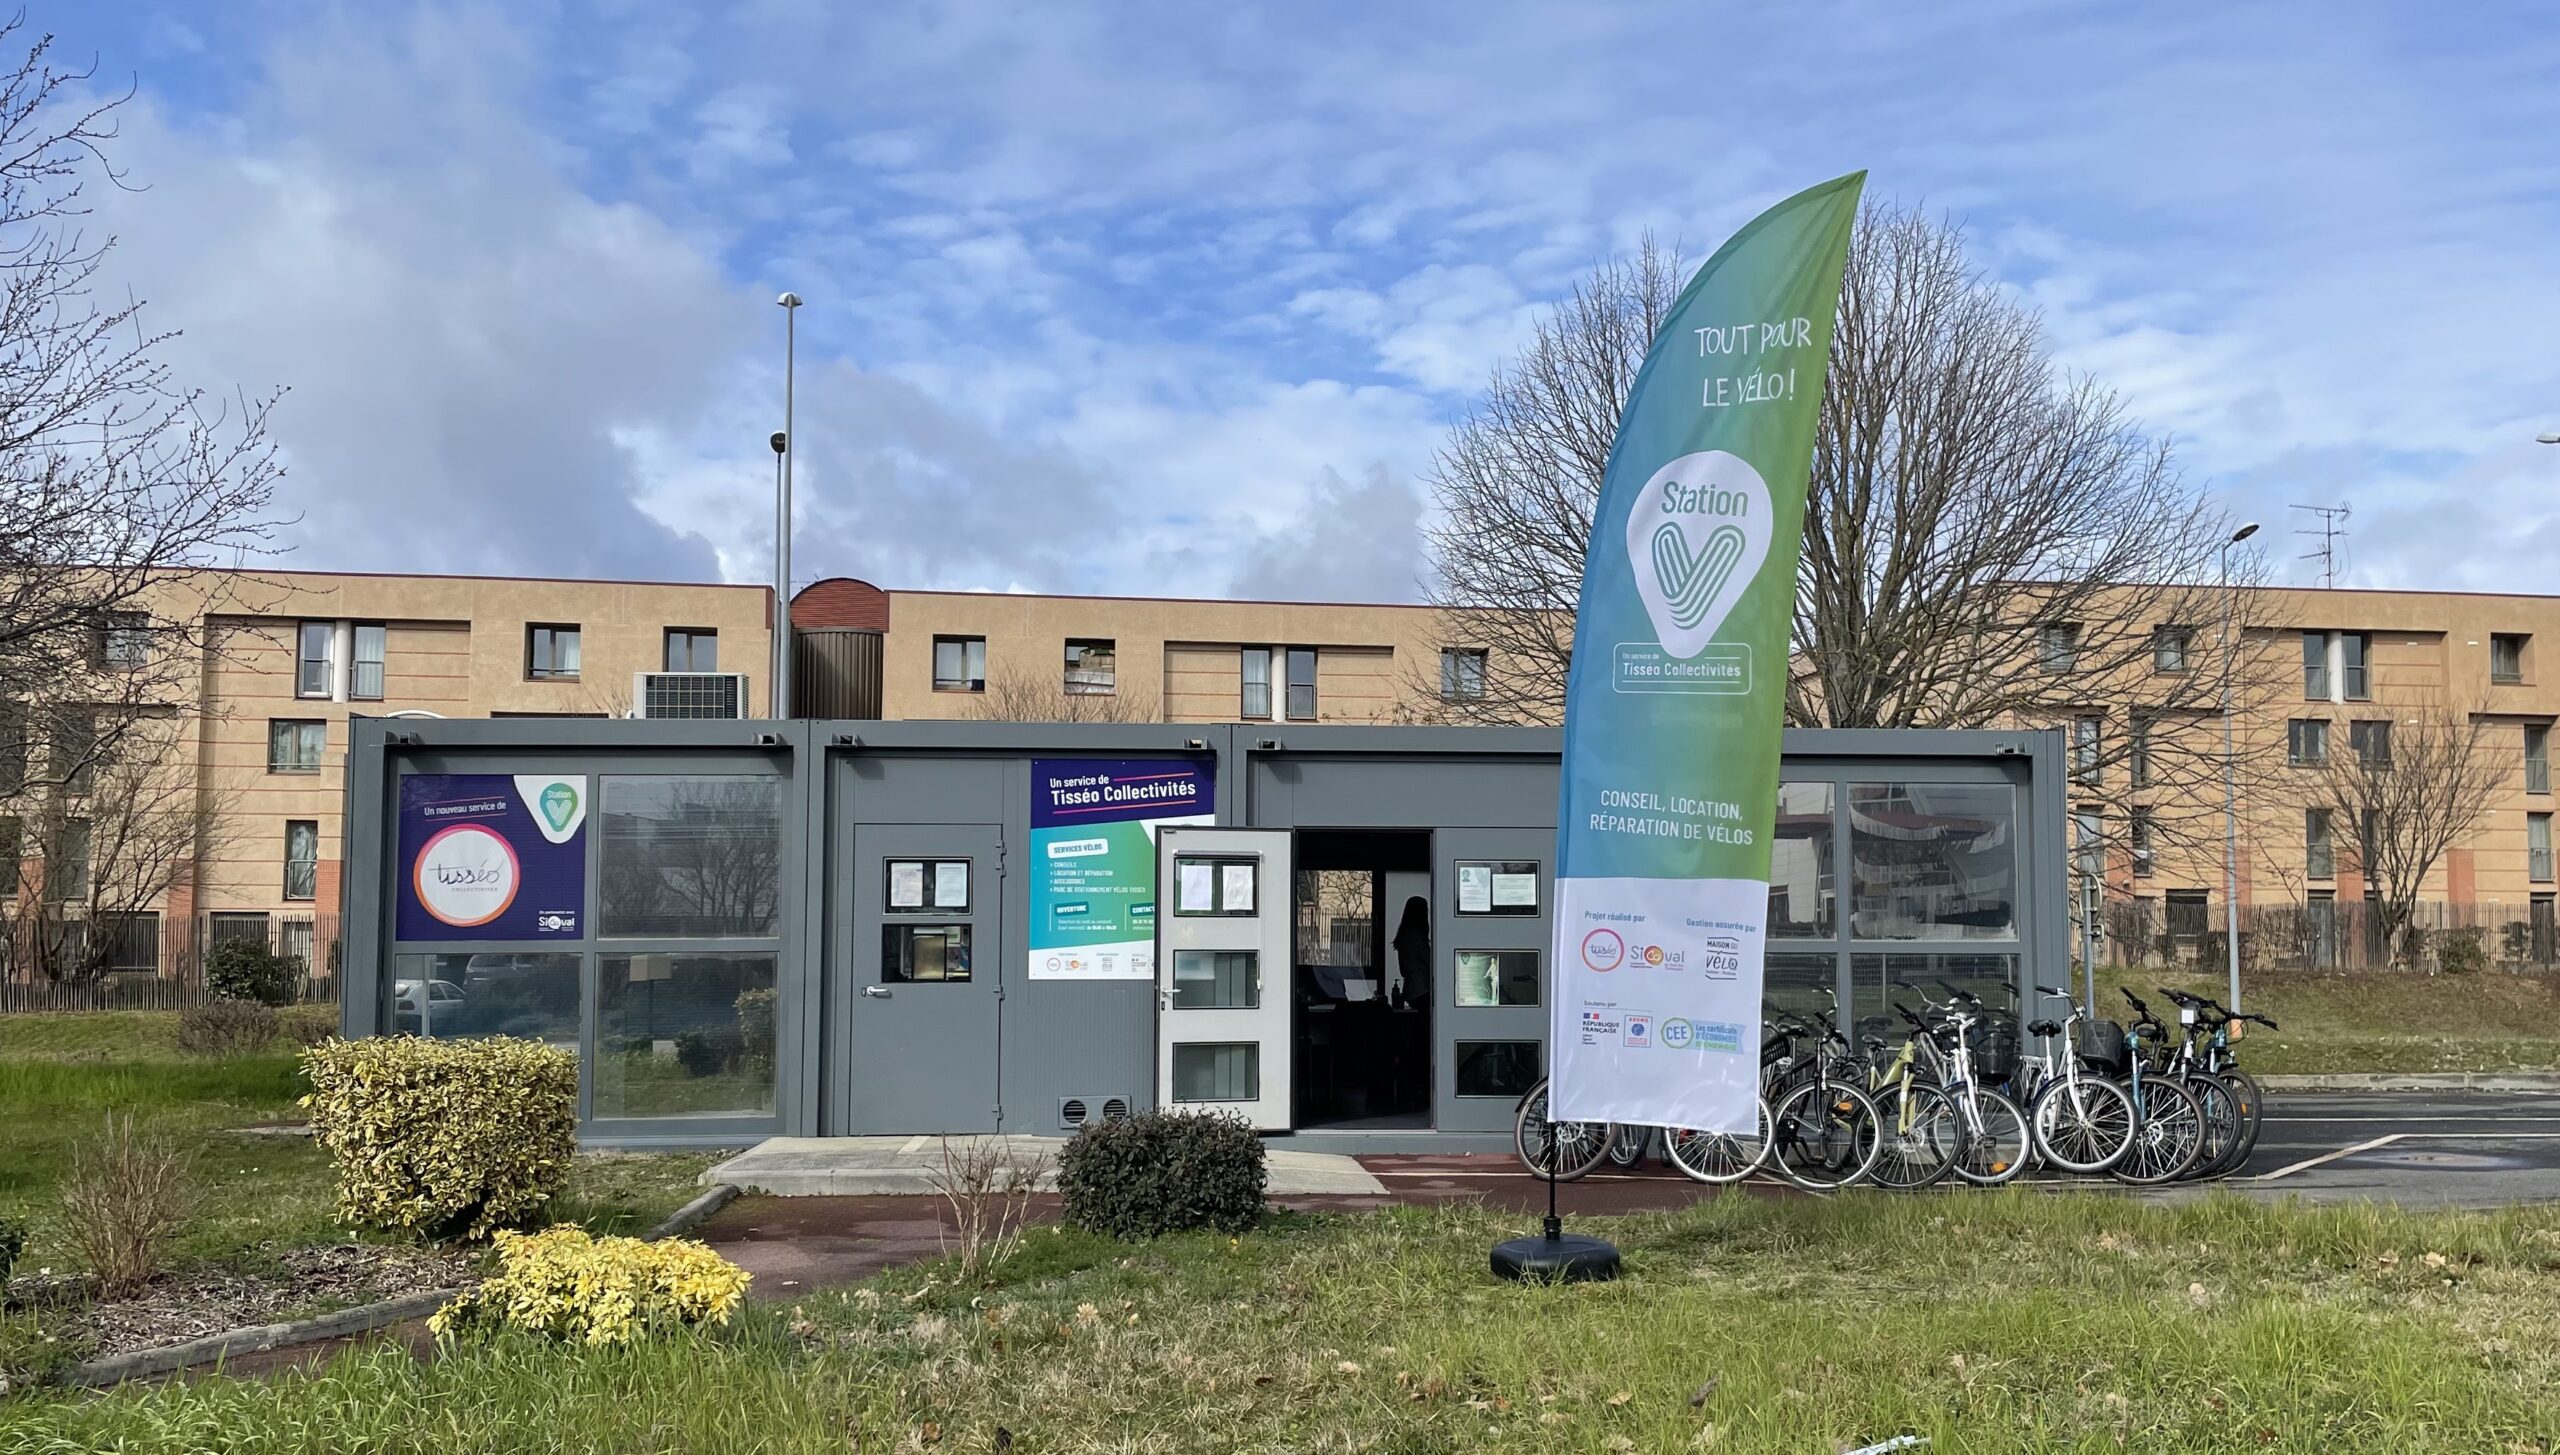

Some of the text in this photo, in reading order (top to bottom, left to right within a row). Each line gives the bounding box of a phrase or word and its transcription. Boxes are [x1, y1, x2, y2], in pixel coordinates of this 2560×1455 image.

[1694, 317, 1811, 357] TOUT POUR
[1703, 378, 1730, 407] LE
[1661, 480, 1749, 517] Station
[1623, 662, 1741, 677] Tisséo Collectivités
[1050, 774, 1110, 789] Un service de
[1051, 780, 1197, 806] Tisséo Collectivités
[424, 801, 507, 816] Un nouveau service de
[1601, 790, 1744, 822] CONSEIL, LOCATION,
[1590, 810, 1754, 845] RÉPARATION DE VÉLOS
[1053, 842, 1103, 854] SERVICES VÉLOS
[1584, 910, 1646, 923] Projet réalisé par
[1686, 918, 1757, 933] Gestion assurée par
[1707, 940, 1730, 949] MAISON
[1583, 1000, 1607, 1008] Soutenu
[1582, 1019, 1620, 1028] RÉPUBLIQUE
[1666, 1025, 1688, 1040] CEE
